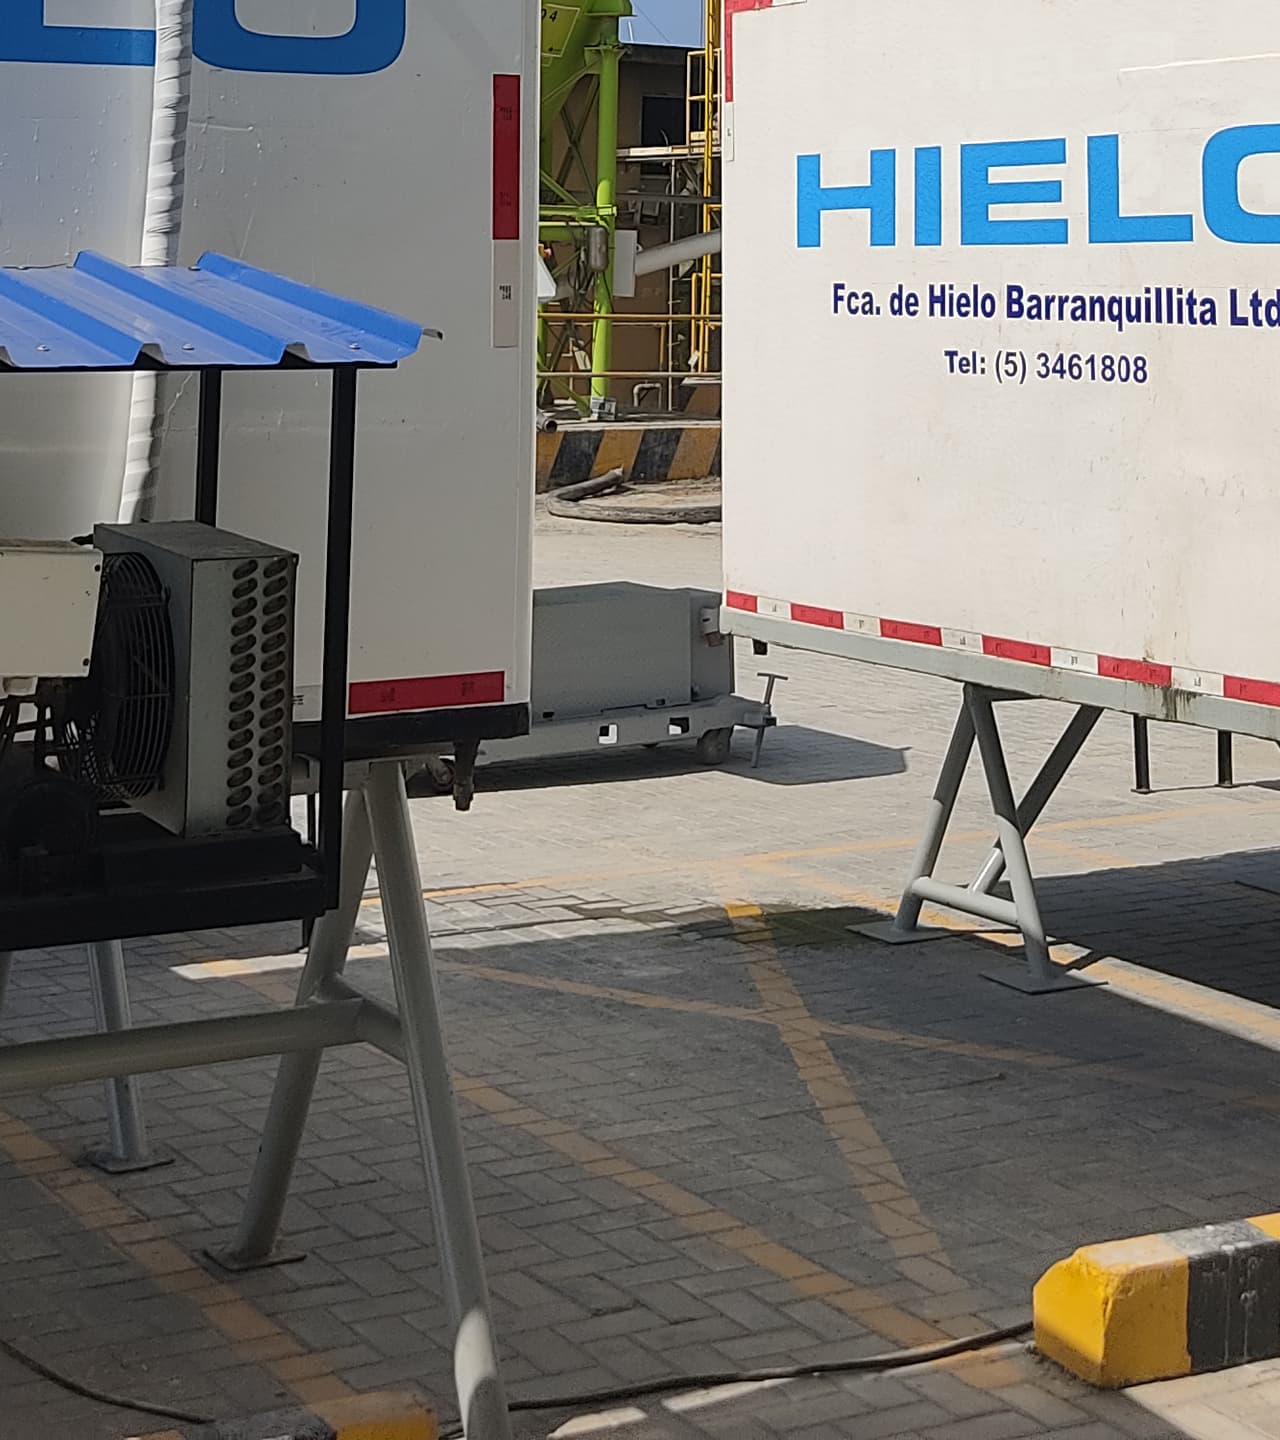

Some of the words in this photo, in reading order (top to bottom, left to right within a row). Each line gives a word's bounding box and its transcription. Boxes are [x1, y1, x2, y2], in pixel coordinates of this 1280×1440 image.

[832, 283, 882, 316] Fca.
[889, 284, 920, 317] de
[928, 284, 997, 319] Hielo
[1005, 285, 1218, 332] Barranquillita
[944, 350, 987, 375] Tel:
[995, 351, 1028, 385] (5)
[1036, 352, 1149, 384] 3461808
